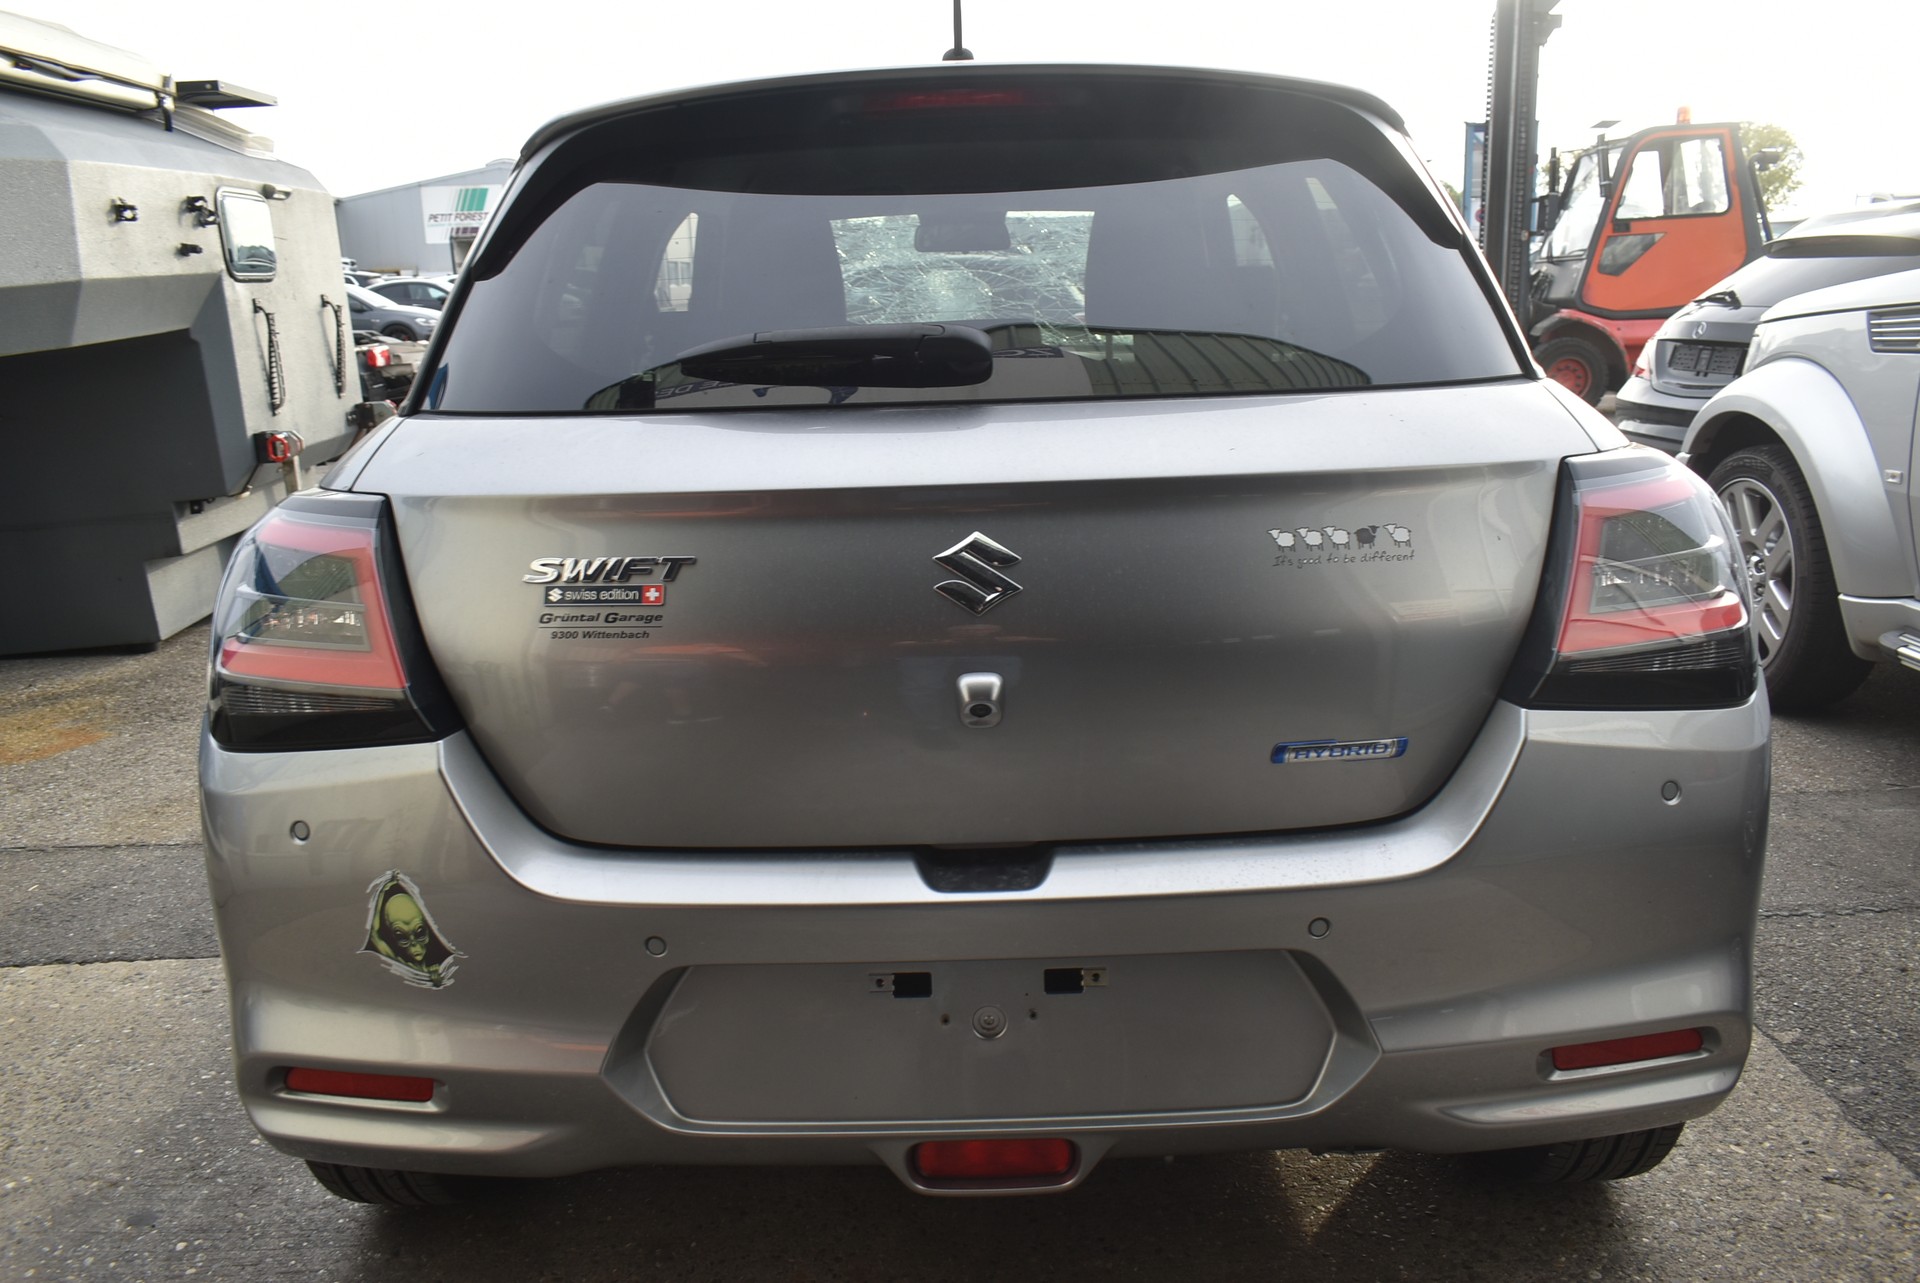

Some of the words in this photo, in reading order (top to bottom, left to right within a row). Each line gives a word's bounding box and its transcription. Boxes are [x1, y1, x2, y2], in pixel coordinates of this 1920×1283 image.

[428, 213, 452, 222] PETIT
[1297, 556, 1322, 569] good
[1326, 553, 1341, 564] to
[1343, 554, 1357, 564] be
[1360, 549, 1416, 563] different
[522, 556, 697, 583] SWIFT
[564, 589, 597, 600] swiss
[600, 588, 639, 600] edition
[539, 613, 600, 624] Grüntal
[604, 612, 663, 624] Garage
[551, 630, 579, 639] 9300
[582, 630, 650, 639] Wittenbach
[1294, 743, 1390, 759] HYBRID
